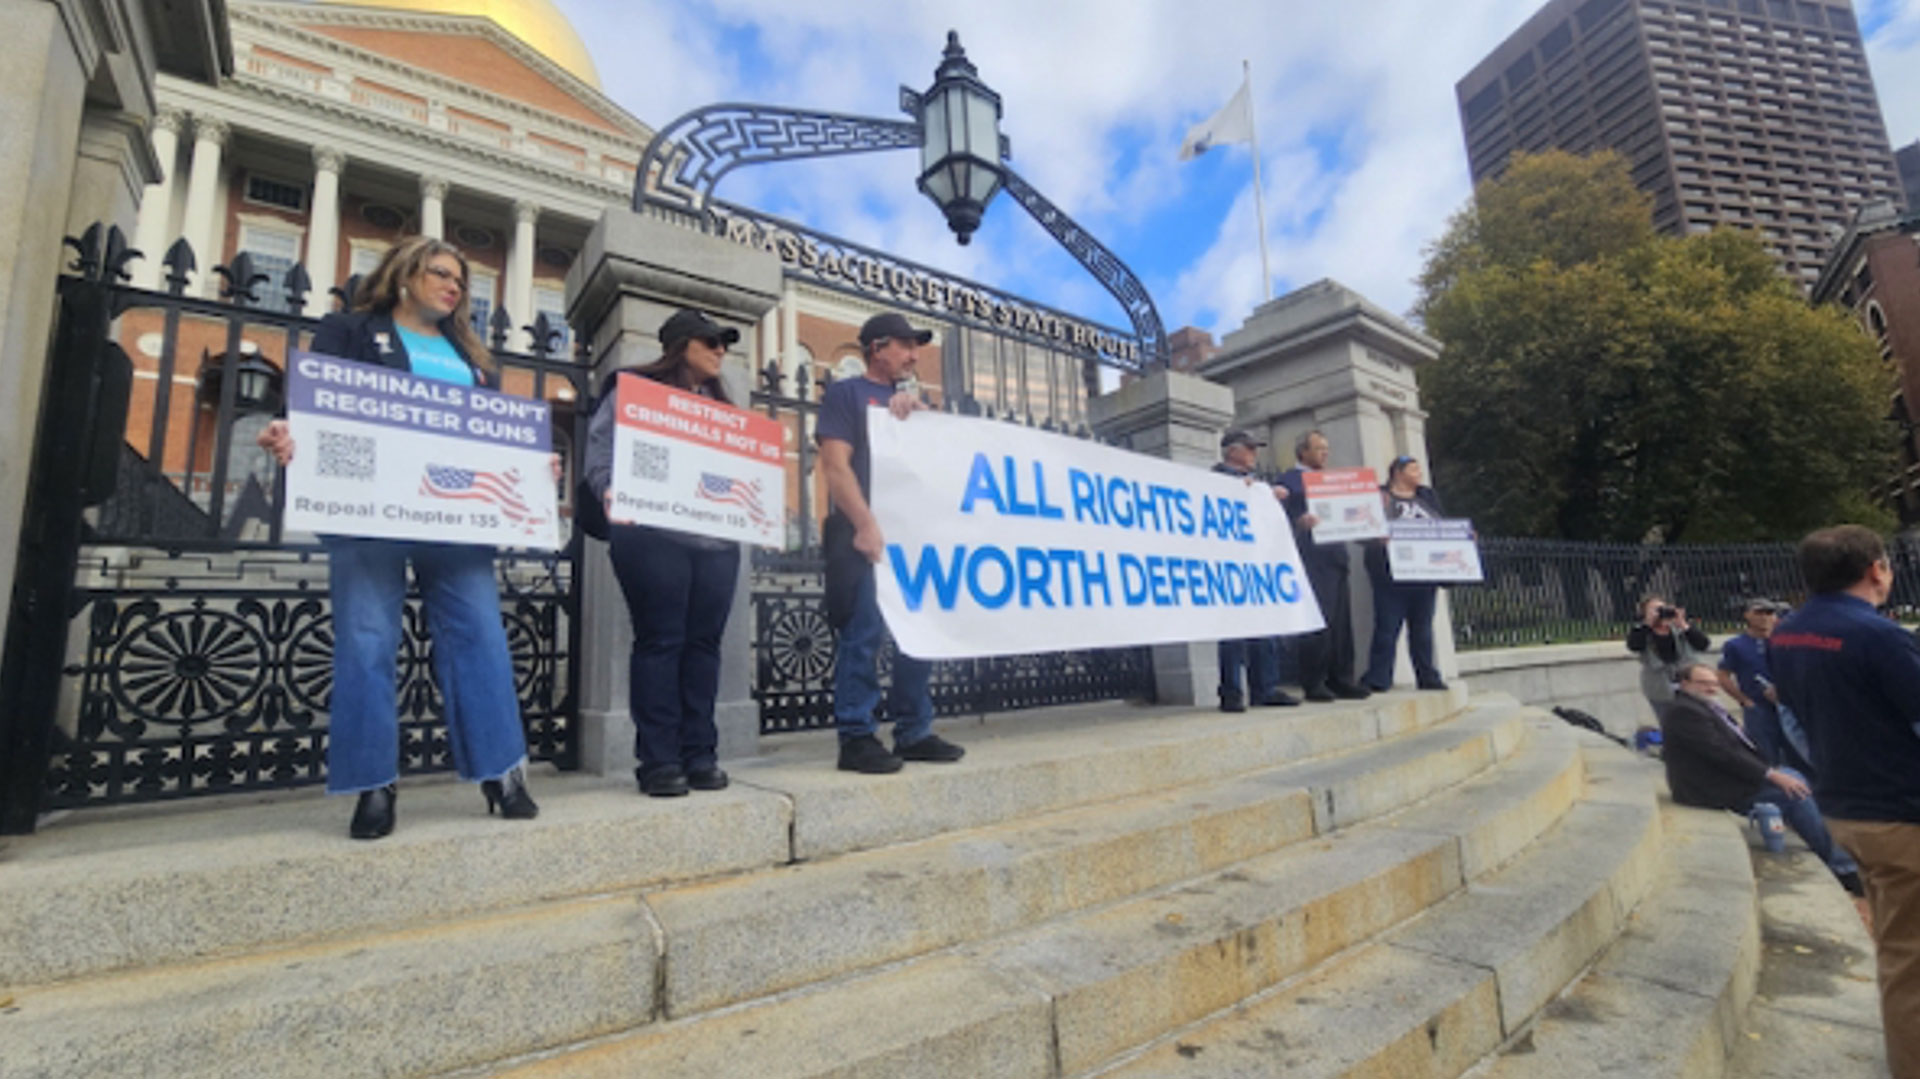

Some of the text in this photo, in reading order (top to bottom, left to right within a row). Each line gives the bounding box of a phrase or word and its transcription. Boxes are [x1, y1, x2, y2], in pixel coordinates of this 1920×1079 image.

[726, 216, 1138, 361] MASSACHUSETTS STATE HOUSE
[298, 358, 464, 407] CRIMINALS
[470, 393, 546, 423] DON'T
[314, 388, 537, 445] REGISTER GUNS
[667, 394, 747, 431] RESTRICT
[624, 403, 781, 460] CRIMINALS NOT US
[295, 496, 499, 528] Repeal Chapter 135
[616, 491, 669, 513] Repeal
[671, 502, 724, 523] Chapter
[960, 451, 1256, 544] ALL RIGHTS ARE
[886, 543, 1301, 613] WORTH DEFENDING
